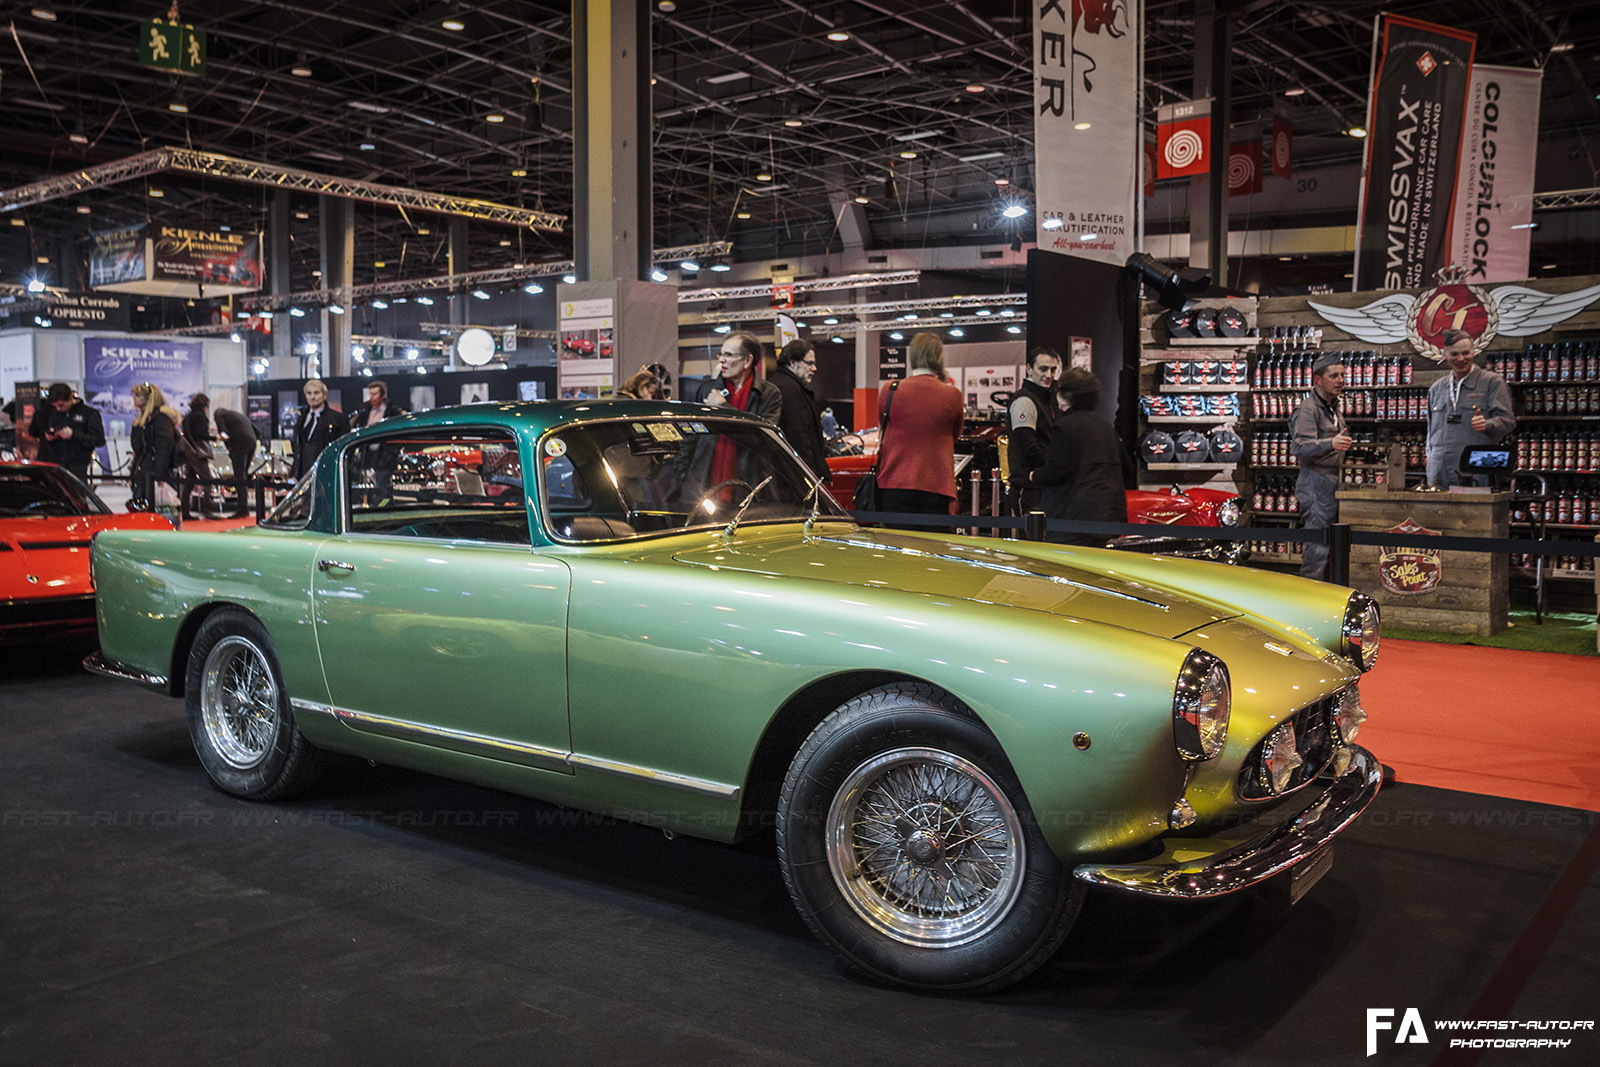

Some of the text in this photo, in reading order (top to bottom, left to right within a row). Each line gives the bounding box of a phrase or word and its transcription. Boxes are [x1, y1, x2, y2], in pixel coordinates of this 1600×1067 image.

[1174, 106, 1194, 117] 1312
[1421, 100, 1432, 135] CARE
[1419, 138, 1428, 164] CAR
[1425, 103, 1442, 198] SWITZERLAND
[1297, 178, 1318, 192] 30
[1471, 81, 1501, 279] COLOURLOCK
[1068, 212, 1076, 221] &
[1081, 213, 1124, 225] LEATHER
[1407, 167, 1426, 262] PERFORMANCE
[1423, 203, 1432, 217] IN
[161, 226, 244, 246] KIENLE
[1043, 222, 1125, 236] AUTIFICATION
[1416, 222, 1430, 259] MADE
[80, 296, 120, 309] Corrado
[101, 346, 189, 361] KIENLE
[1389, 561, 1419, 579] Sales
